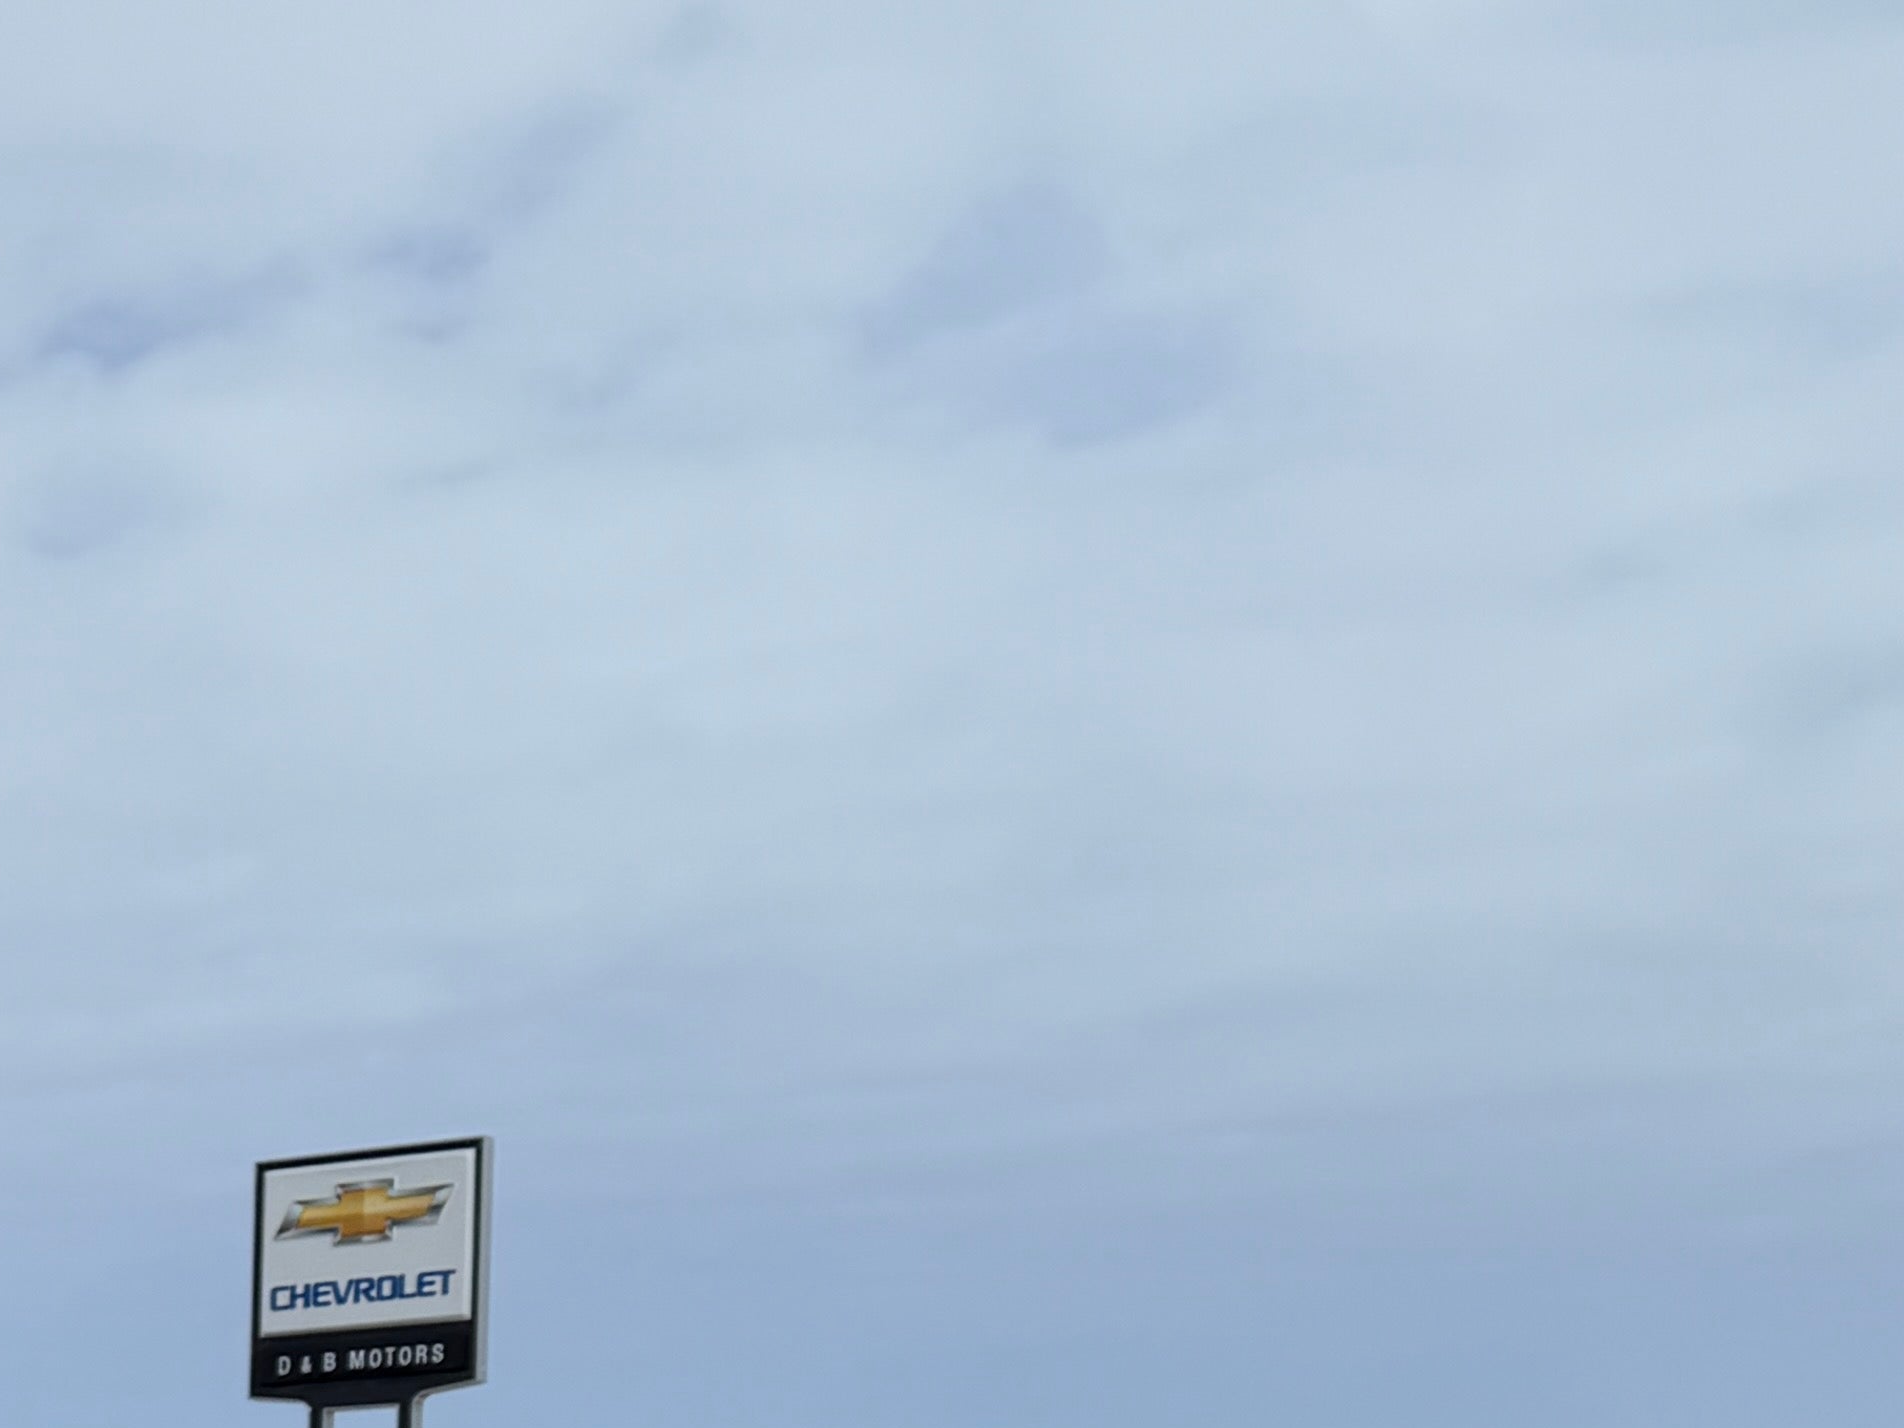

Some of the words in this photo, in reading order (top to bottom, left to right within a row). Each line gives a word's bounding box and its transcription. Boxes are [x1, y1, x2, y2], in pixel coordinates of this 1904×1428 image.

[269, 1269, 456, 1312] CHEVROLET
[277, 1355, 291, 1376] D
[300, 1354, 312, 1374] &
[323, 1352, 337, 1372] B
[349, 1343, 445, 1370] MOTORS
